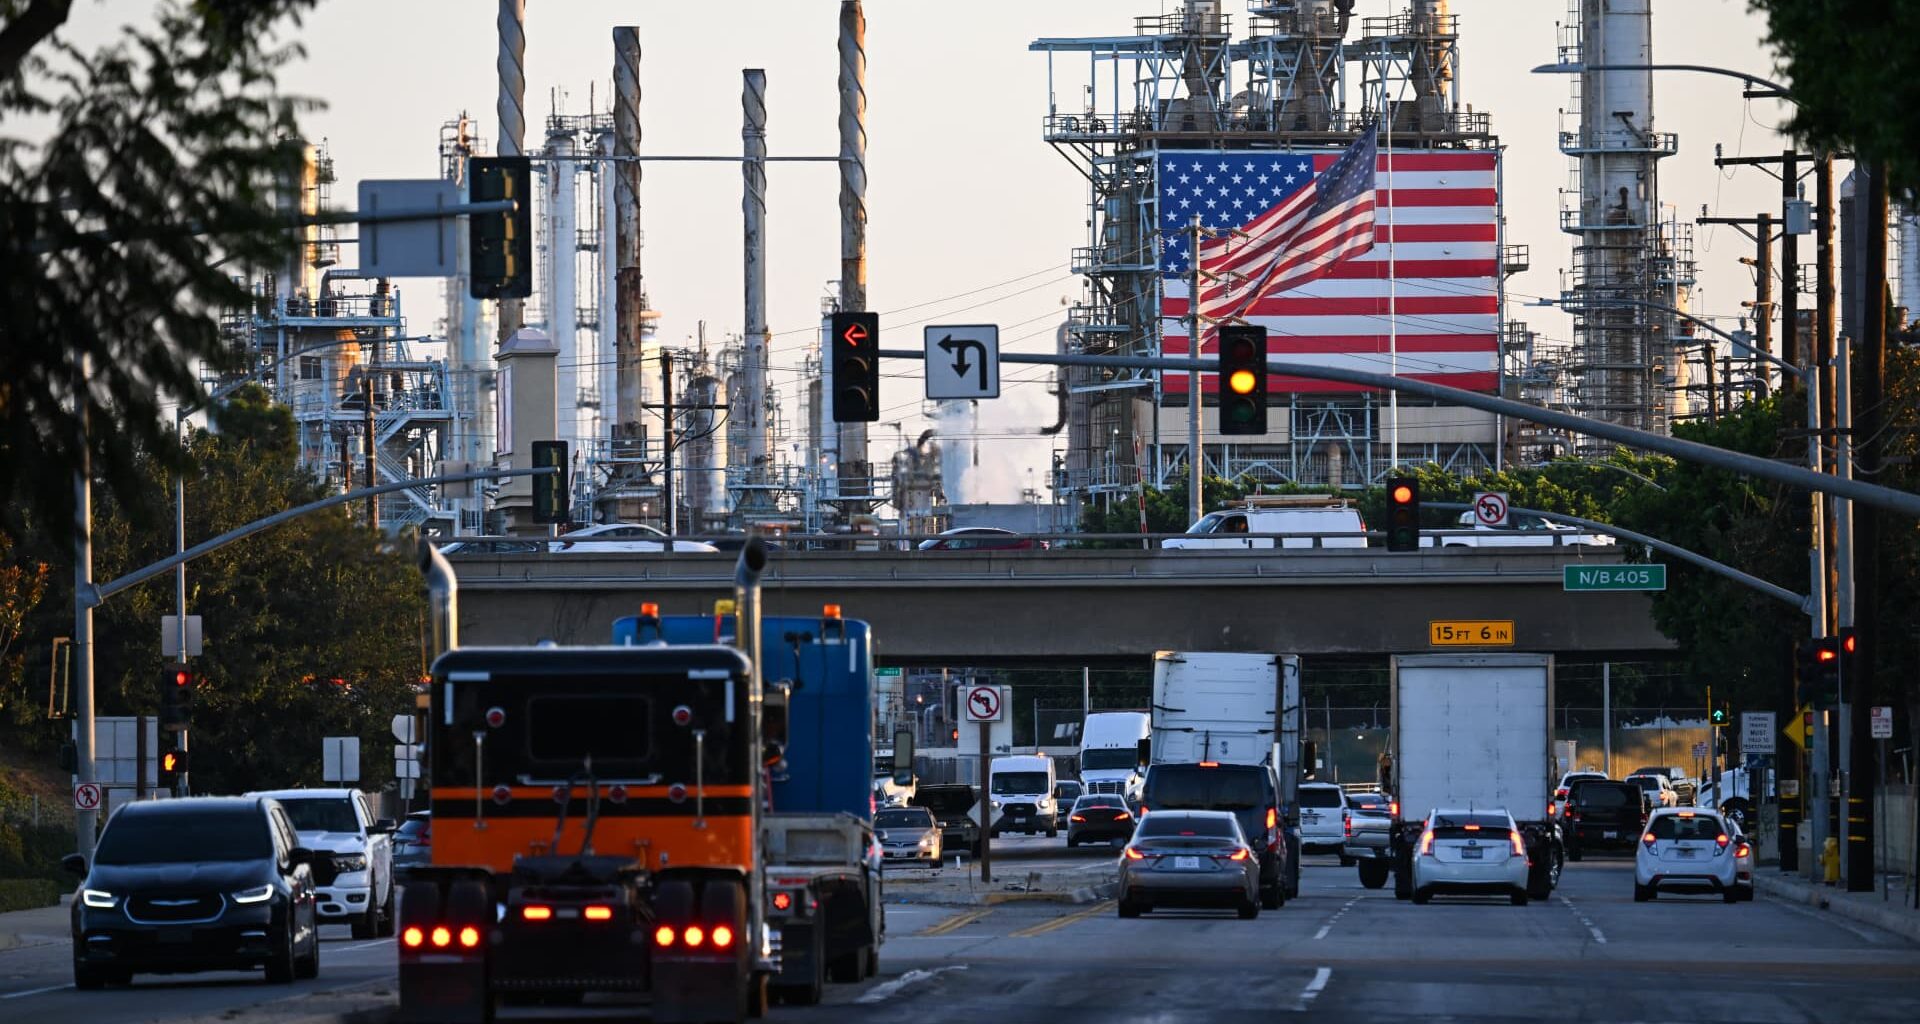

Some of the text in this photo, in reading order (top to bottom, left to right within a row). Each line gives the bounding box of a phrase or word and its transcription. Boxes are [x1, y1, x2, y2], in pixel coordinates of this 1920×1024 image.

[1579, 569, 1650, 585] N/B 405
[1436, 626, 1508, 640] 15 FT 6 IN
